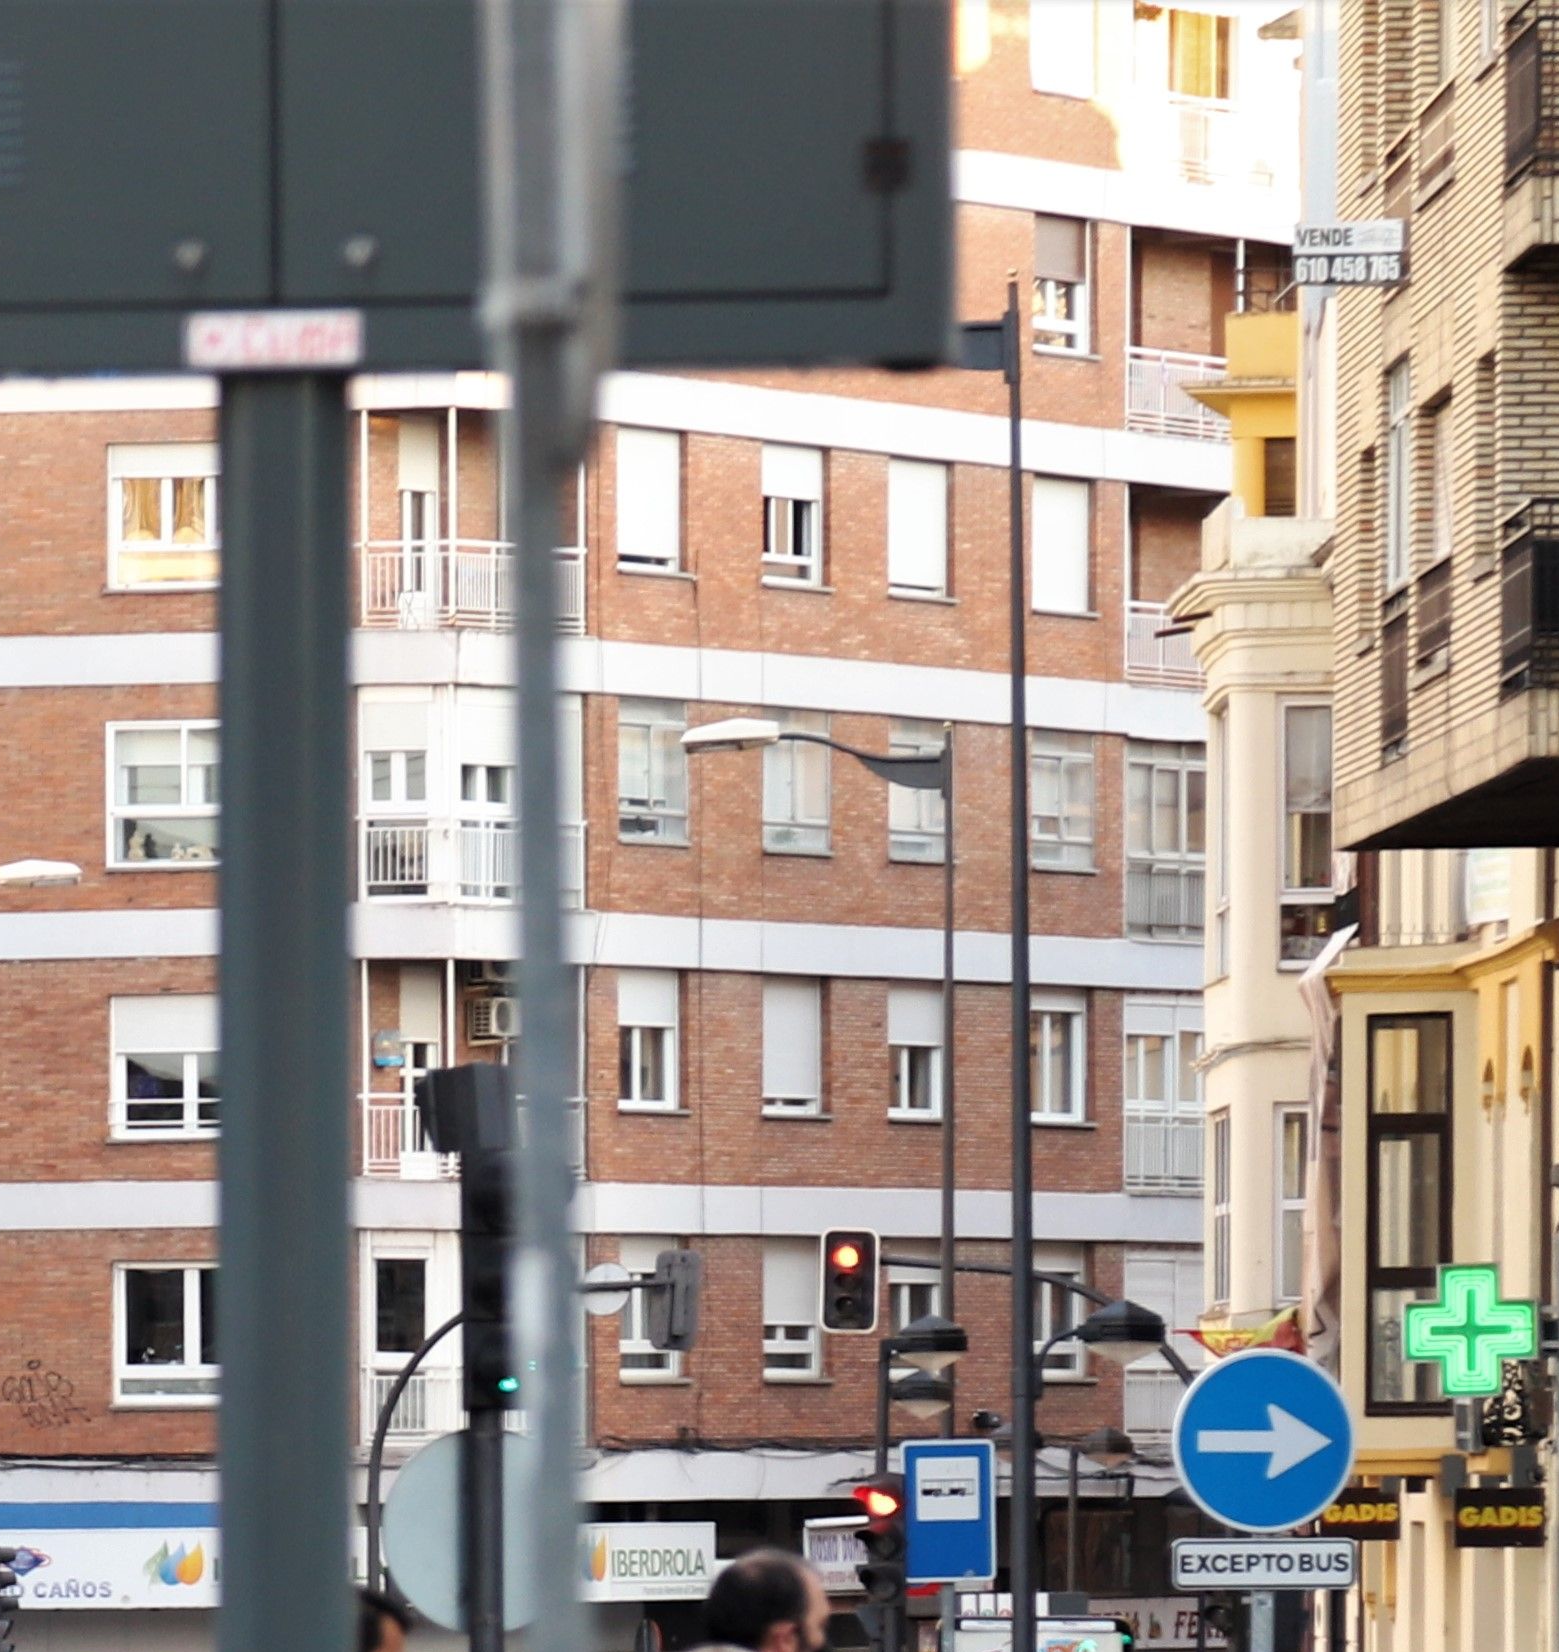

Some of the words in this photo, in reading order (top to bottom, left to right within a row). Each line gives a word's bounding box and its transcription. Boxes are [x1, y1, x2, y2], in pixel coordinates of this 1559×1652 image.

[1296, 227, 1354, 247] VENDE
[1295, 256, 1329, 283] 610
[1322, 1502, 1399, 1525] GADIS
[1456, 1504, 1545, 1529] GADIS
[610, 1548, 706, 1577] IBERDROLA
[1180, 1553, 1294, 1575] EXCEPTO
[1298, 1551, 1350, 1573] BUS
[33, 1579, 113, 1599] CAÑOS
